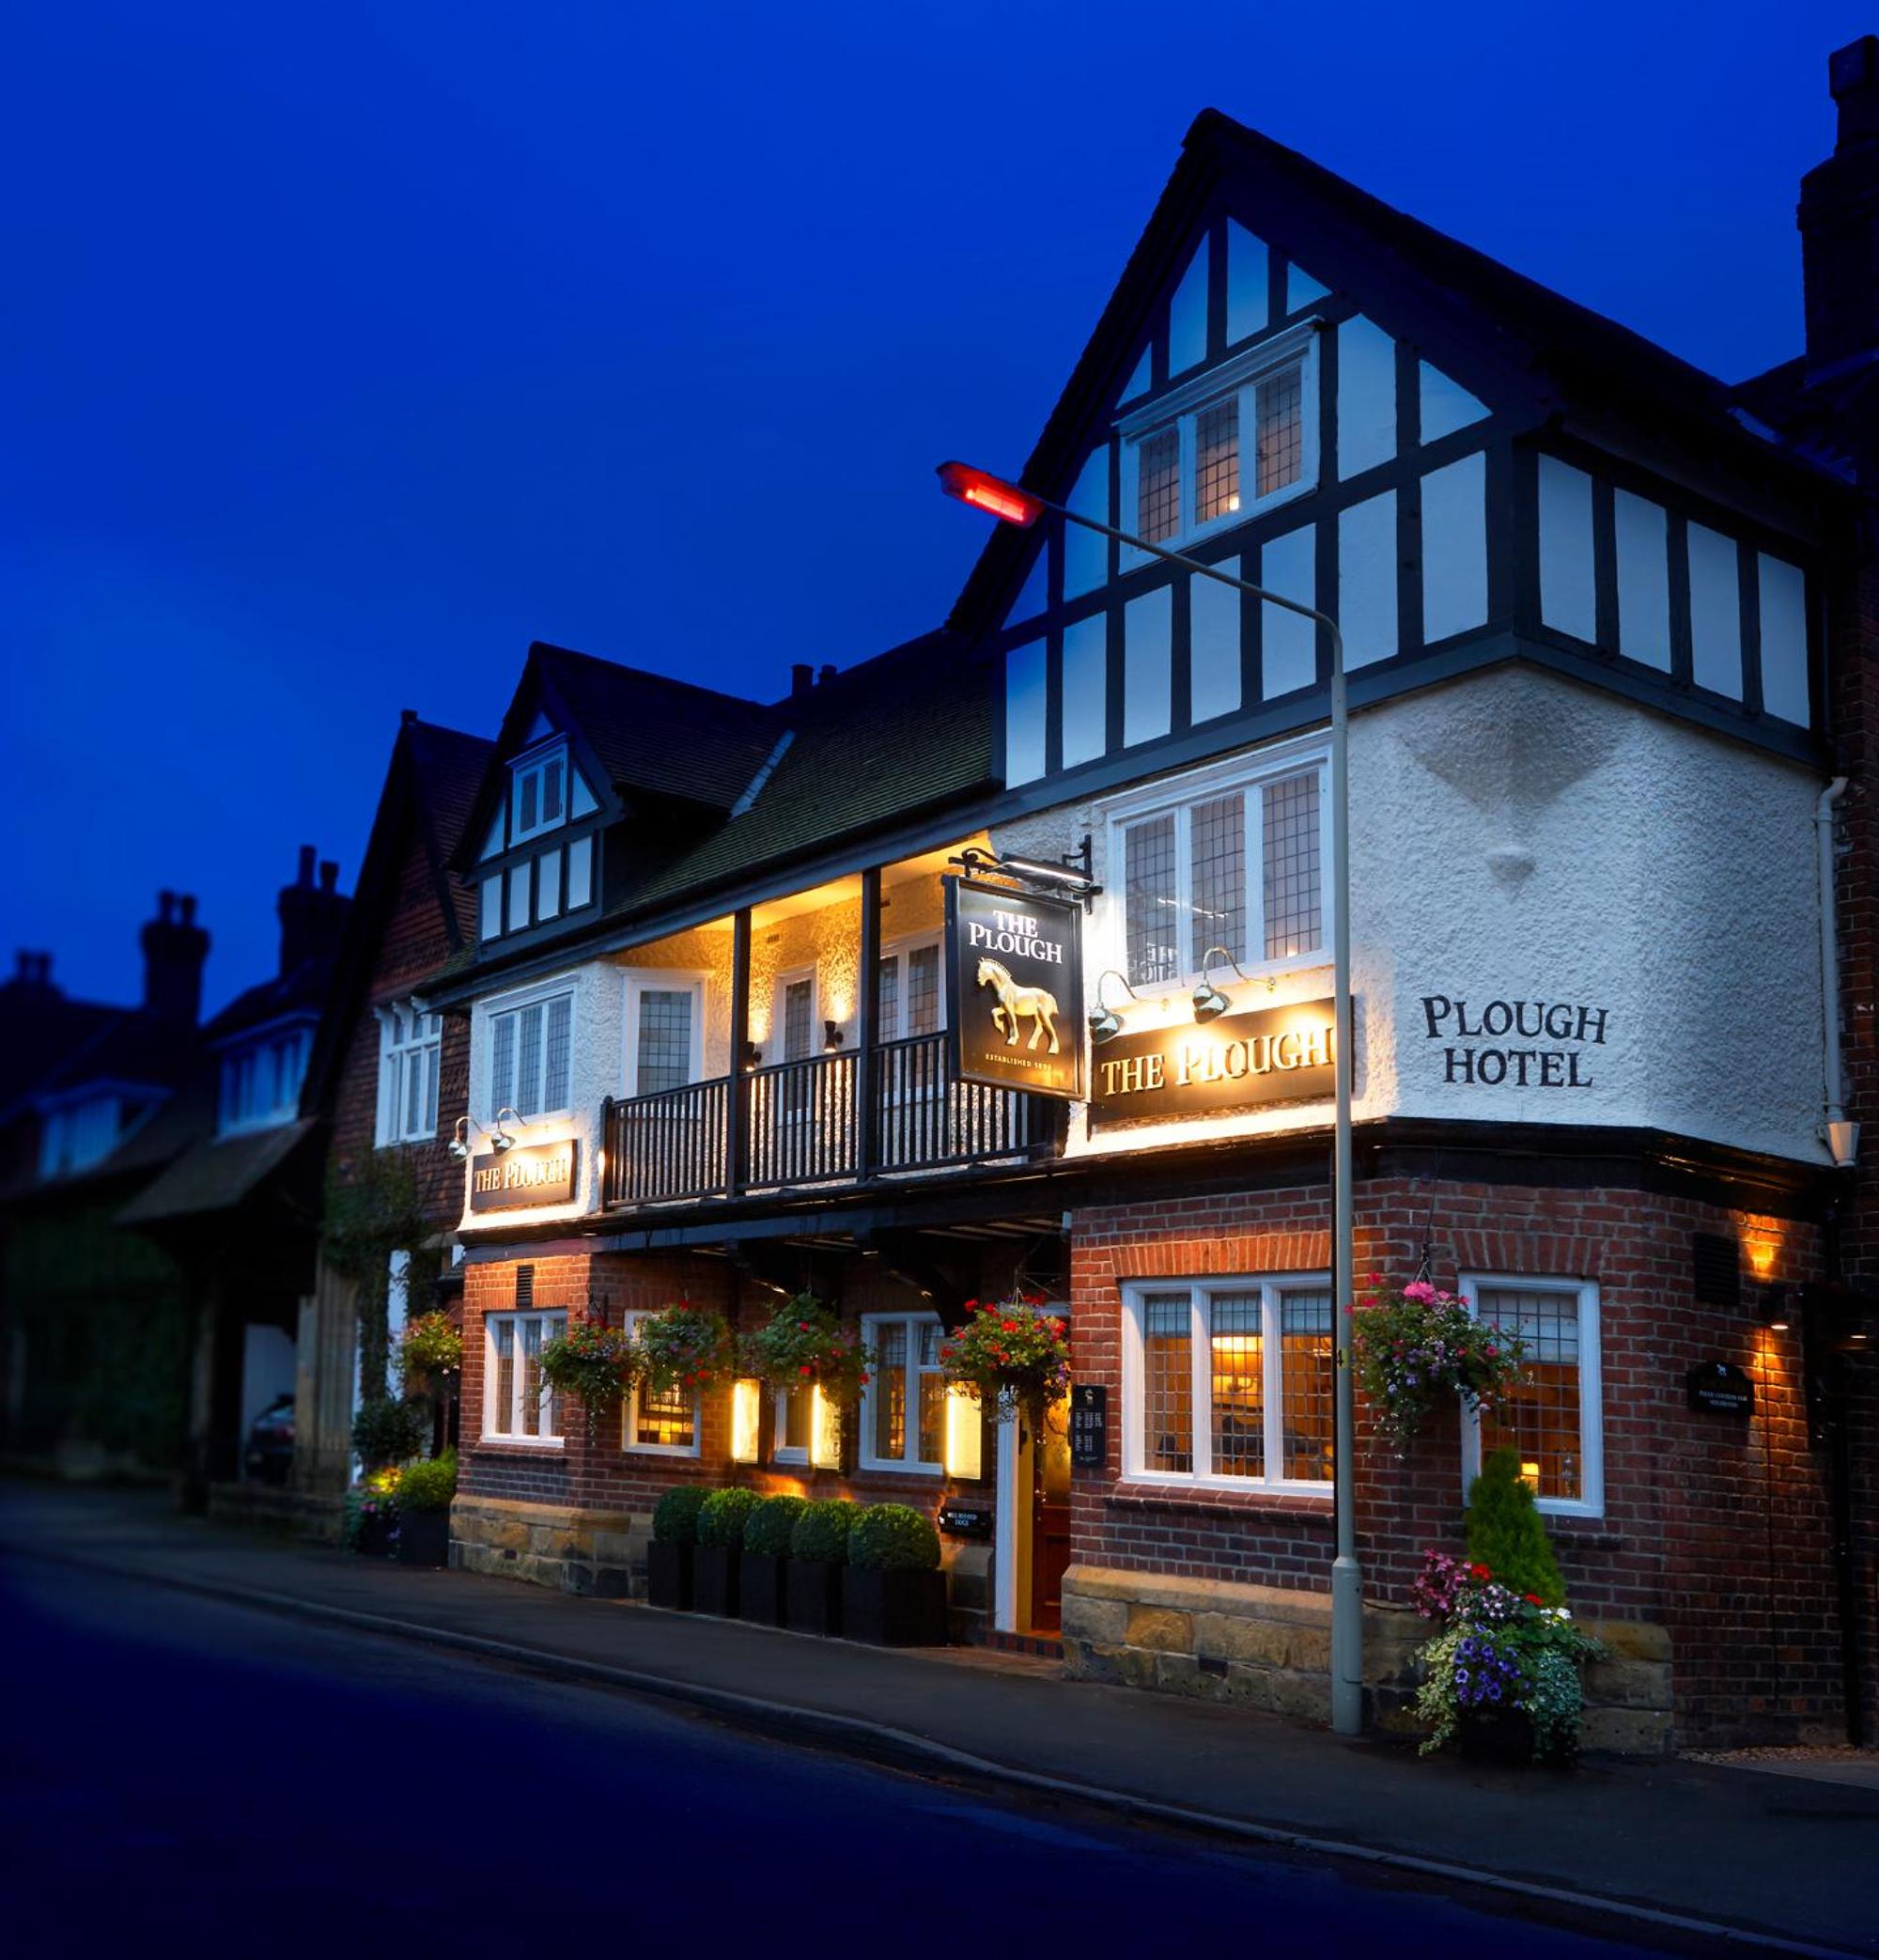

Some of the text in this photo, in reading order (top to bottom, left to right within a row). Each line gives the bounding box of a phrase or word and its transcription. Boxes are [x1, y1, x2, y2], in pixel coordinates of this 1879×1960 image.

[969, 922, 1064, 964] PLOUGH
[993, 910, 1038, 938] THE
[1420, 995, 1609, 1045] PLOUGH
[985, 1053, 1032, 1067] ESTABLISHED
[1100, 1027, 1334, 1096] THE PLOUGH
[1443, 1048, 1593, 1087] HOTEL
[474, 1167, 501, 1192] THE
